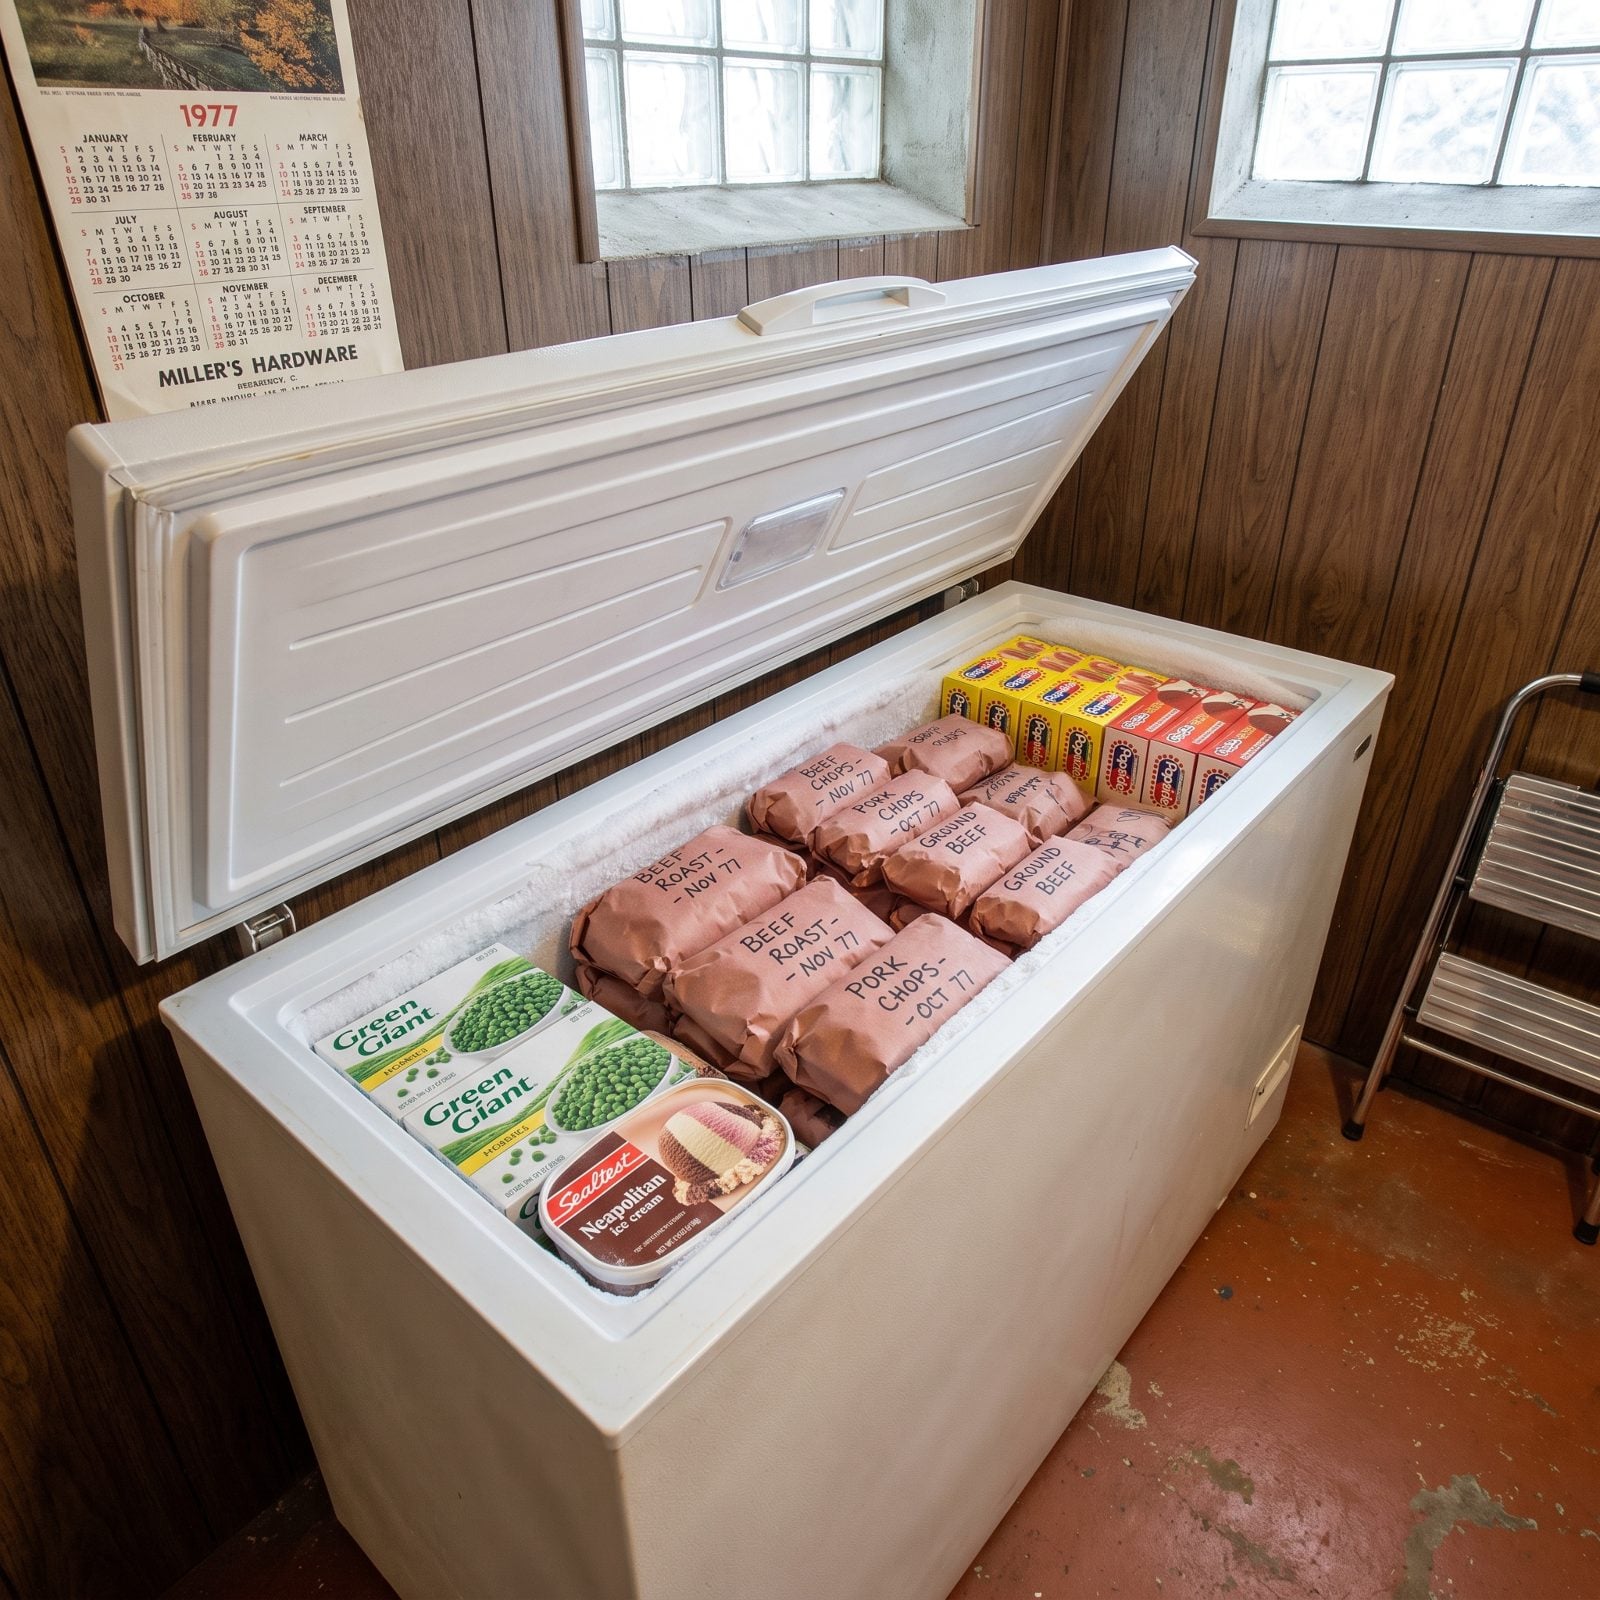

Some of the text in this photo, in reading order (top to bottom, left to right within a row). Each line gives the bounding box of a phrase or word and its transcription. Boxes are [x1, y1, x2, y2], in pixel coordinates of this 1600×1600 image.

[180, 104, 238, 127] 1977
[83, 134, 128, 142] JANUARY
[193, 134, 236, 142] FEBRUARY
[115, 216, 136, 224] JULY
[214, 210, 248, 219] AUGUST
[304, 205, 346, 214] SEPTEMBER
[223, 282, 268, 293] NOVEMBER
[318, 275, 358, 284] DECEMBER
[123, 292, 165, 303] OCTOBER
[159, 345, 358, 387] MILLER'S HARDWARE
[800, 755, 838, 778] BEEF
[829, 782, 854, 803] NOV
[857, 770, 874, 785] 77
[852, 792, 896, 813] PORK
[879, 790, 923, 820] CHOPS
[924, 801, 940, 817] 77
[920, 812, 976, 848] GROUND
[946, 825, 987, 854] BEEF
[633, 850, 685, 884] BEEF
[719, 859, 741, 874] 77
[1004, 848, 1061, 890] GROUND
[1036, 861, 1076, 895] BEEF
[740, 913, 795, 953] BEEF
[800, 947, 834, 977] NOV
[834, 931, 860, 951] 77
[845, 956, 907, 999] PORK
[949, 970, 974, 991] 77
[333, 1000, 418, 1050] Green
[358, 1007, 435, 1056] Giant
[423, 1068, 514, 1126] Green
[452, 1076, 534, 1133] Giant
[559, 1152, 635, 1210] Sealtest
[579, 1175, 666, 1240] Neapolitan
[610, 1221, 629, 1236] ice
[630, 1195, 664, 1222] cream
